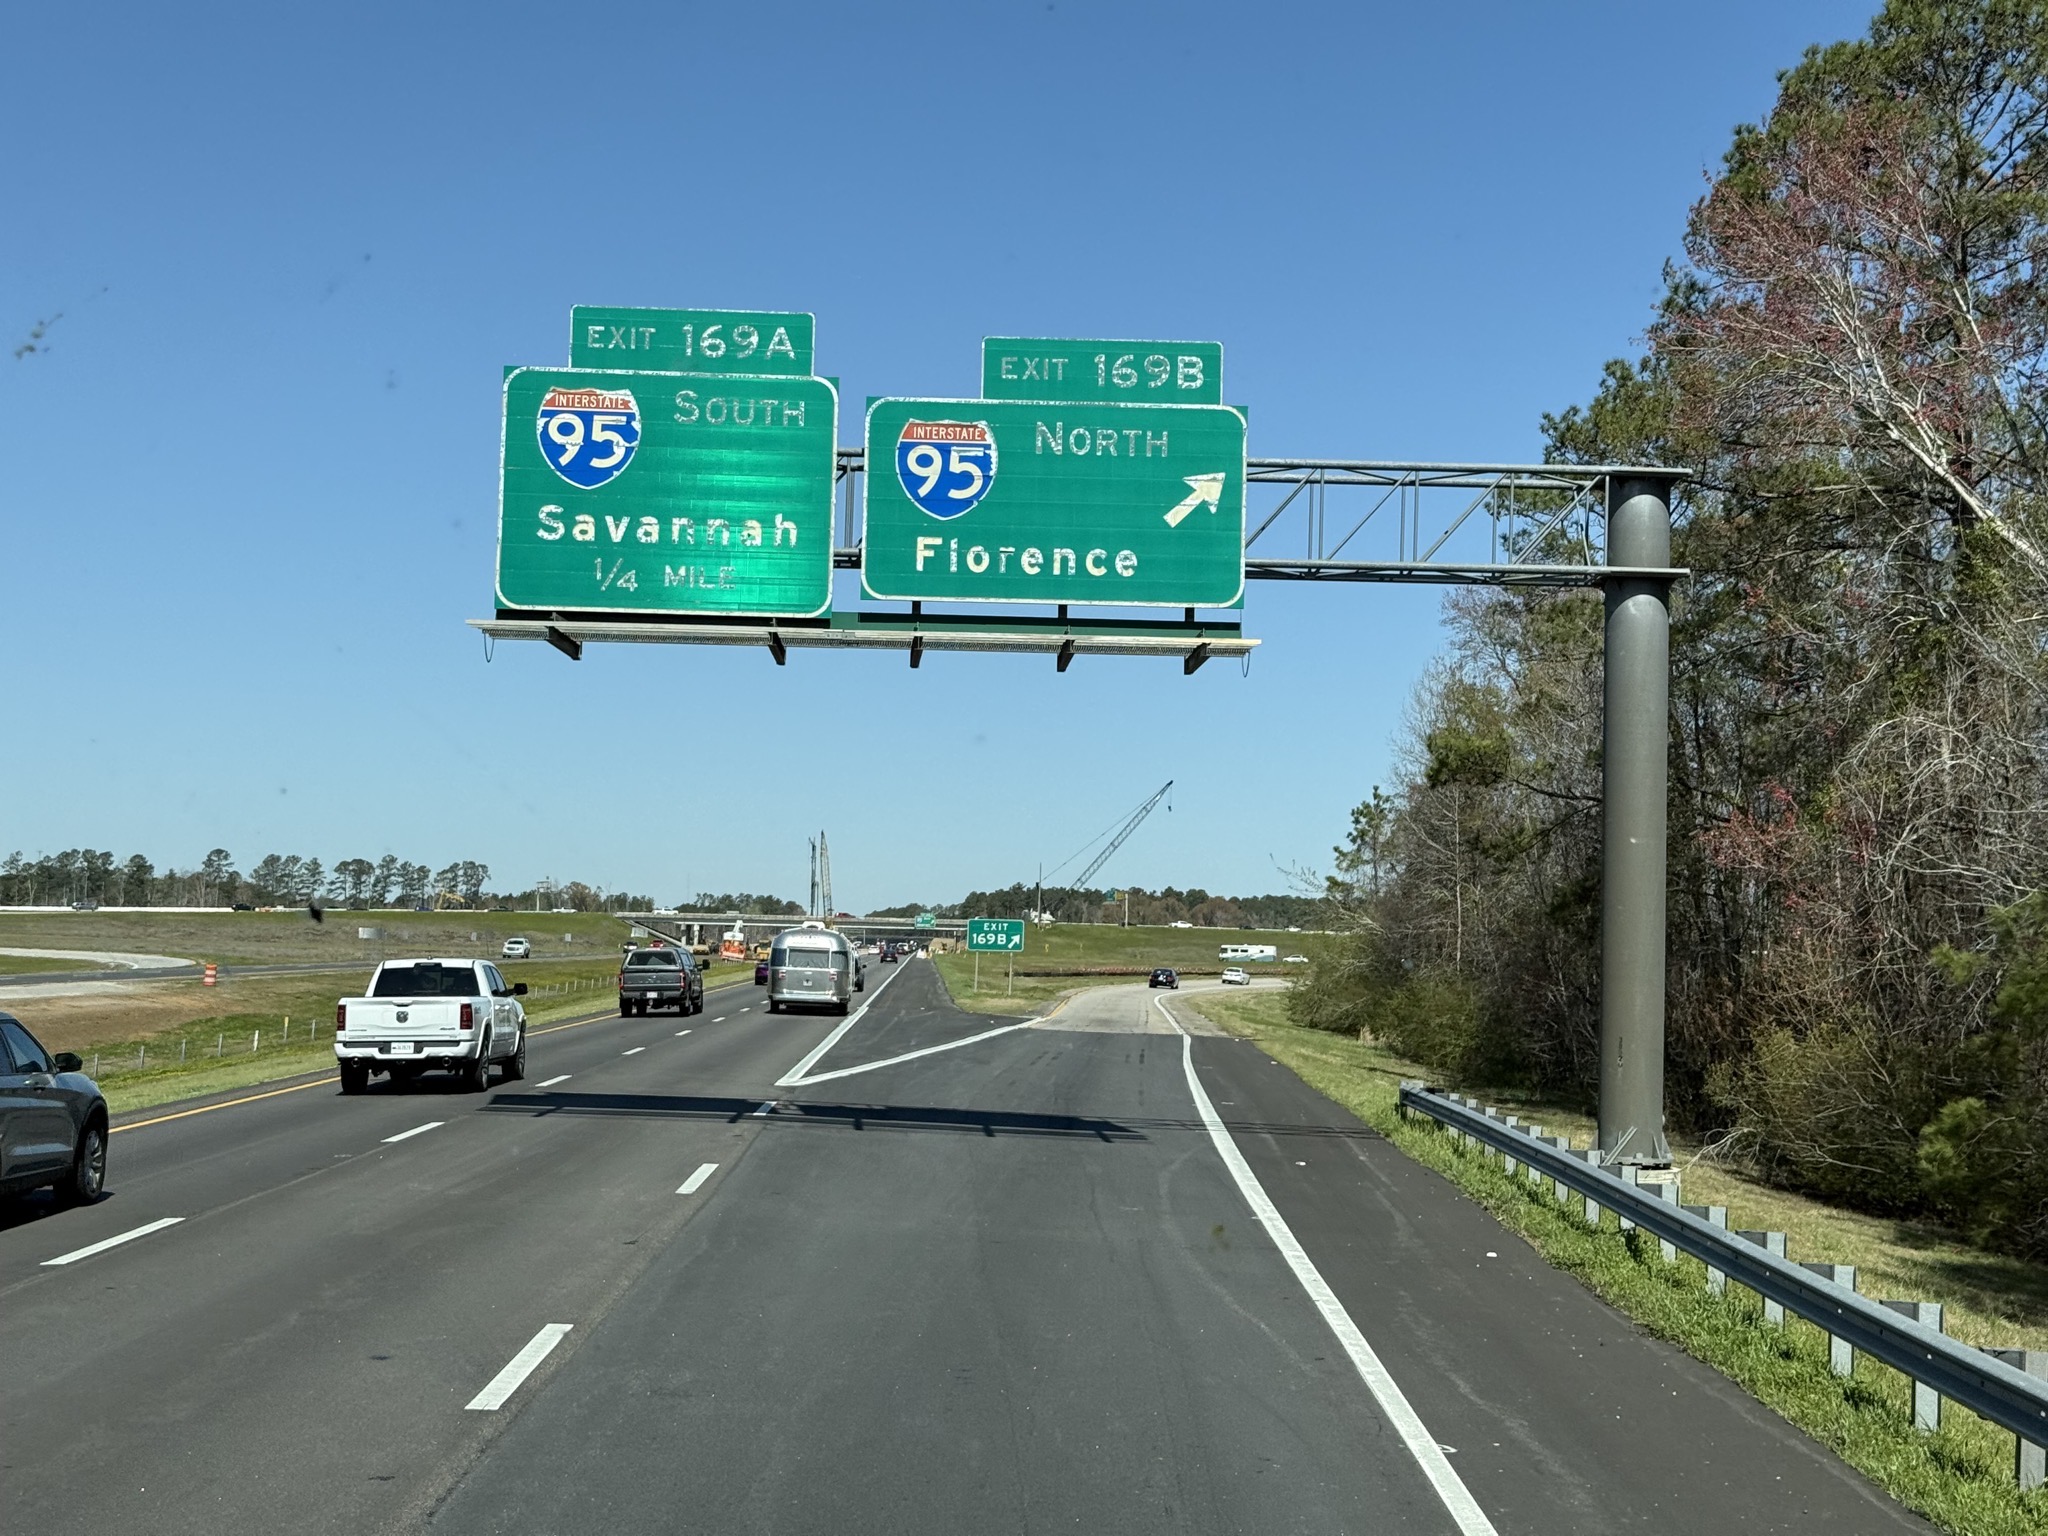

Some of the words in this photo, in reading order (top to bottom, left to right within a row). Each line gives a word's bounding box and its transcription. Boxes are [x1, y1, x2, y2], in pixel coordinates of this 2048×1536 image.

[587, 325, 656, 350] EXIT
[681, 323, 795, 361] 169A
[1000, 357, 1069, 381] EXIT
[1094, 353, 1205, 390] 169B
[554, 393, 625, 409] INTERSTATE
[673, 390, 806, 428] SOUTH
[547, 412, 628, 469] 95
[913, 426, 983, 441] INTERSTATE
[1035, 421, 1169, 458] NORTH
[906, 444, 984, 500] 95
[536, 504, 798, 548] Savannah
[915, 536, 1139, 578] Florence
[664, 564, 737, 591] MILE
[972, 933, 1006, 945] 169B
[983, 922, 1008, 931] EXIT
